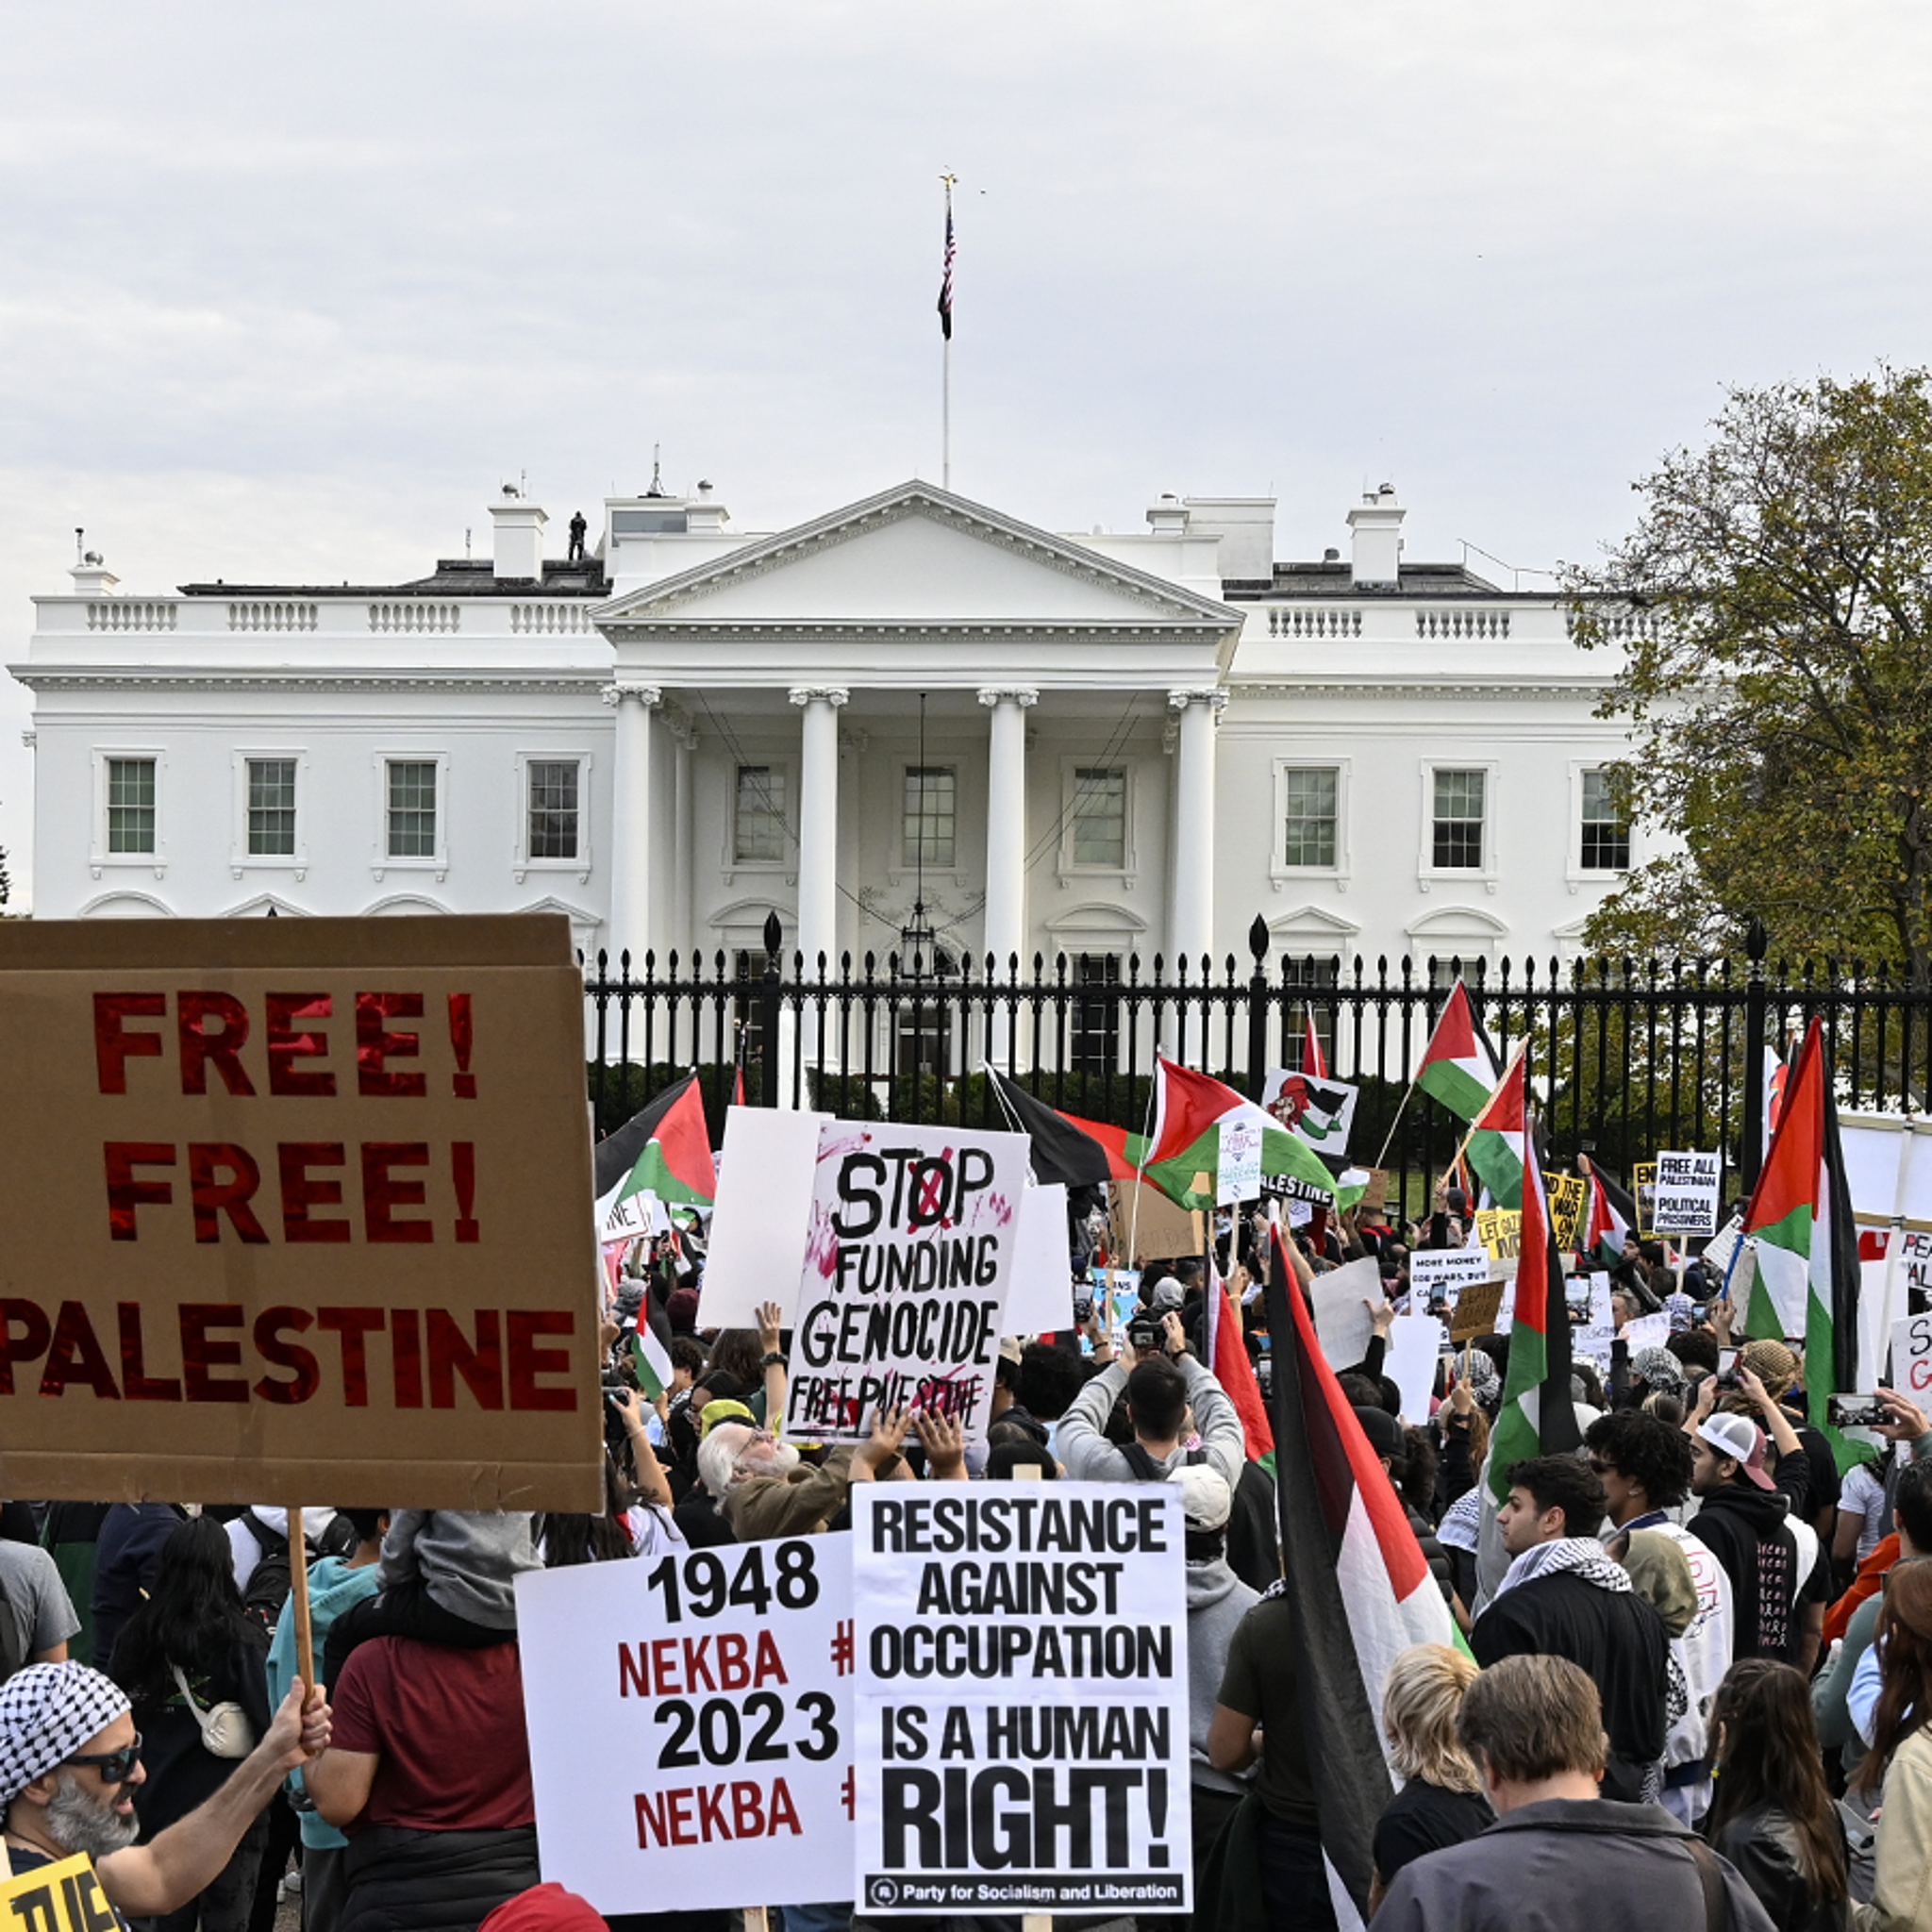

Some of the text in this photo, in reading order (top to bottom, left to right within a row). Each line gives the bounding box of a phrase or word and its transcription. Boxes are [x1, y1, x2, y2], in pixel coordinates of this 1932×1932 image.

[92, 991, 478, 1099] FREE!
[103, 1141, 480, 1244] FREE!
[831, 1147, 995, 1239] STOP
[1260, 1174, 1332, 1204] ALESTINE
[1638, 1166, 1657, 1183] EN
[1661, 1158, 1716, 1174] FREE ALL
[1657, 1213, 1712, 1226] PRISONERS
[1658, 1198, 1712, 1213] POLITICAL
[834, 1235, 998, 1295] FUNDING
[0, 1298, 579, 1411] PALESTINE
[800, 1299, 999, 1368] GENOCIDE
[787, 1374, 853, 1429] FREE
[872, 1498, 1167, 1554] RESISTANCE
[647, 1540, 820, 1624] 1948
[917, 1562, 1124, 1616] AGAINST
[618, 1629, 788, 1698] NEKBA
[870, 1624, 1174, 1679] OCCUPATION
[654, 1690, 839, 1770] 2023
[882, 1706, 1171, 1761] IS A HUMAN
[634, 1777, 802, 1850] NEKBA
[881, 1766, 1170, 1871] RIGHT!
[903, 1885, 945, 1902] Party
[951, 1884, 974, 1899] for
[977, 1885, 1056, 1900] Socialism
[1058, 1884, 1091, 1899] and
[1094, 1884, 1177, 1899] Liberation
